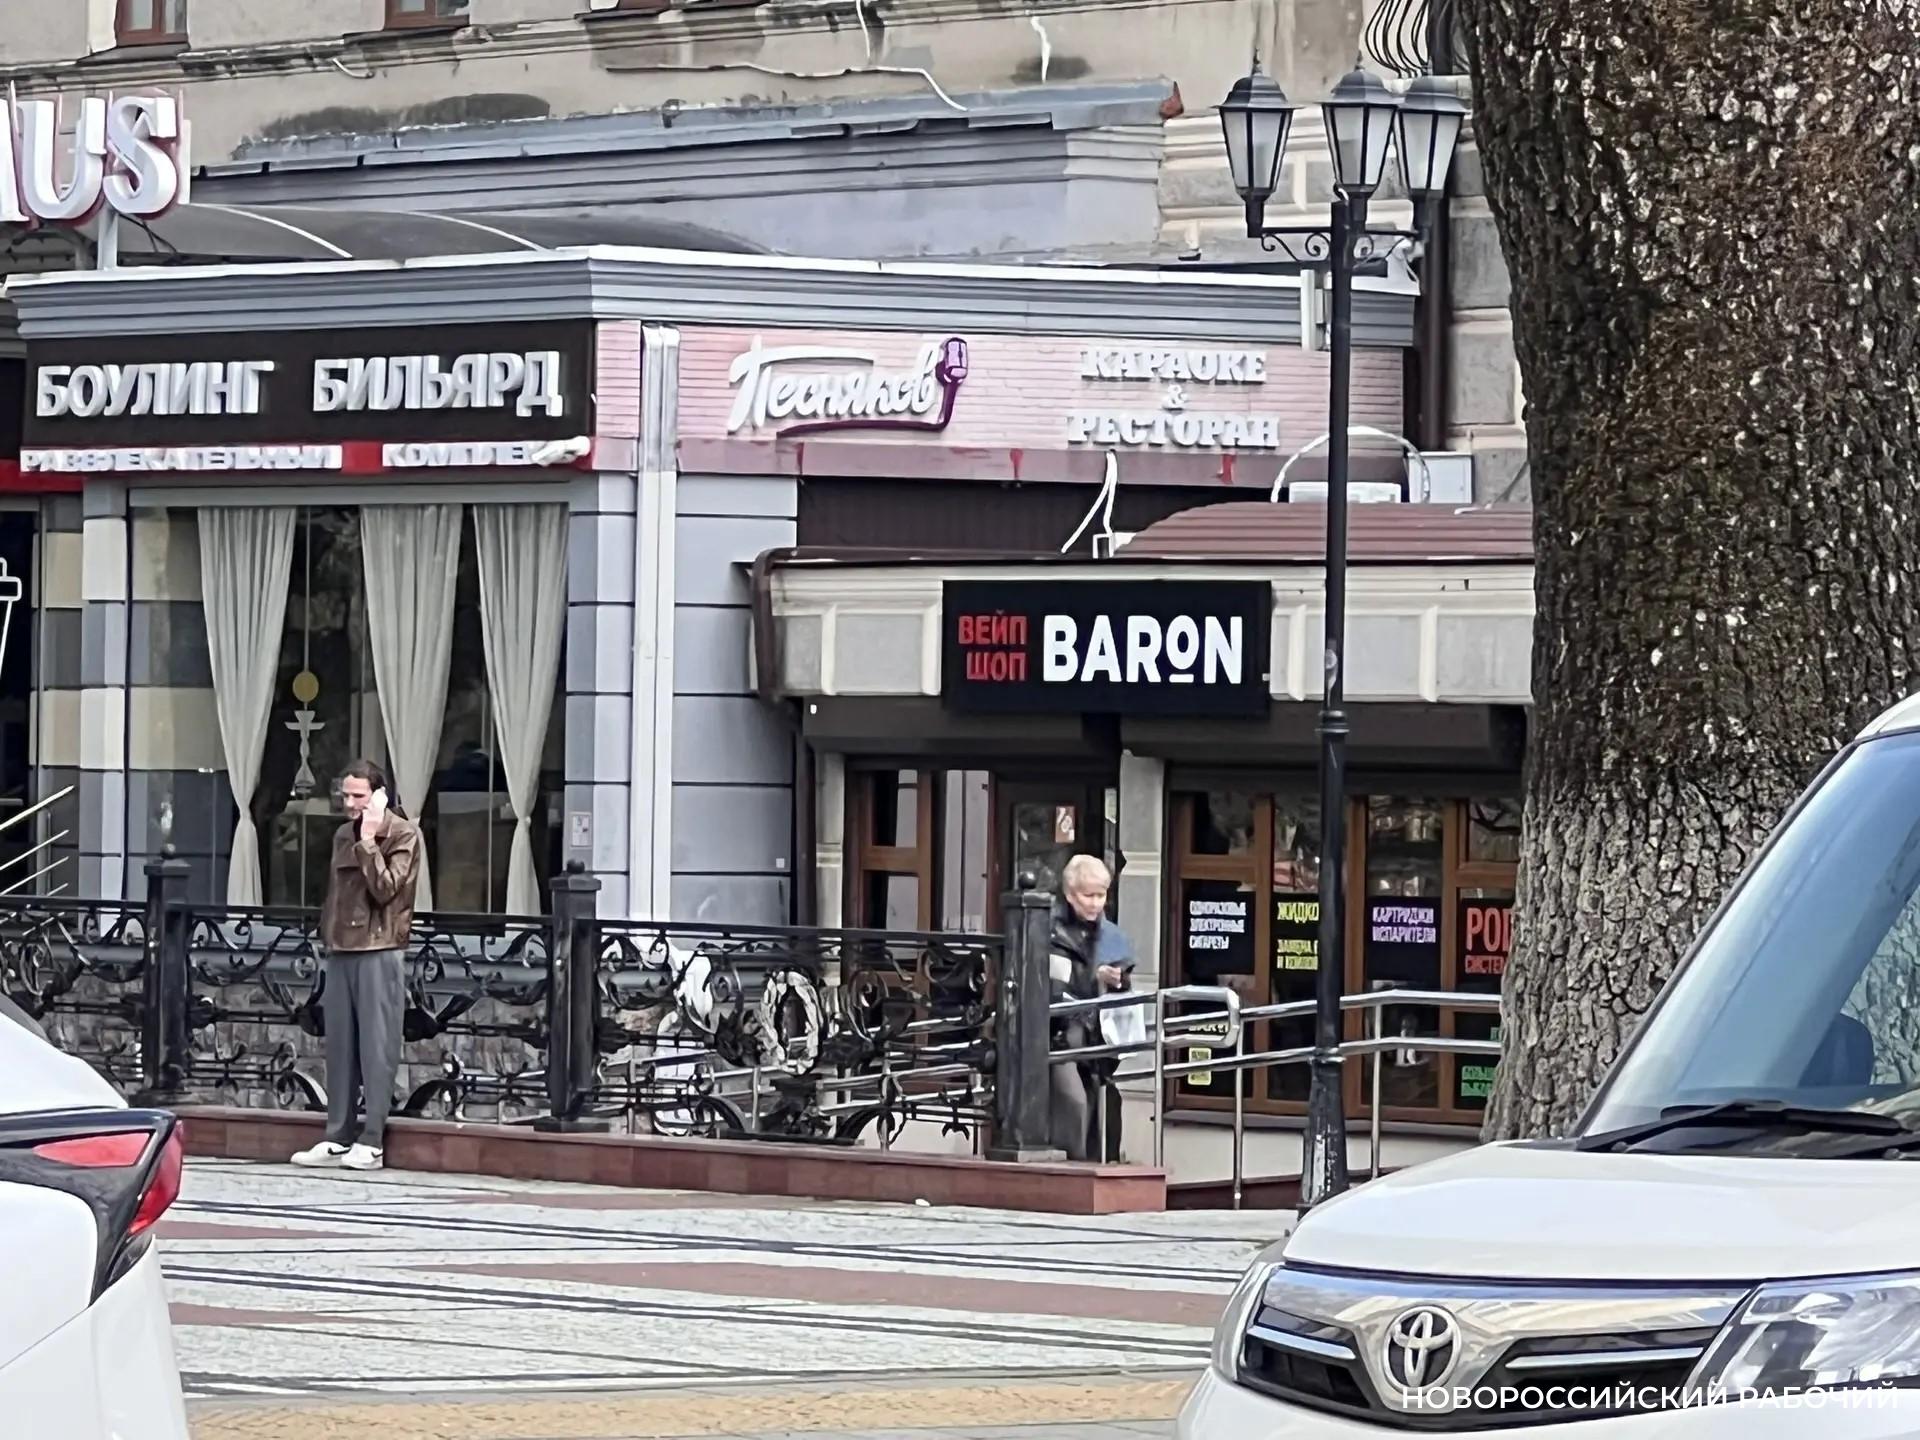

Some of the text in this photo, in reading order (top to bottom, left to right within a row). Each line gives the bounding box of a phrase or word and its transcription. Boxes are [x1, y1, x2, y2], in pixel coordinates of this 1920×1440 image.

[0, 96, 177, 221] US
[37, 351, 563, 417] БОУЛИНГ БИЛЬЯРД
[1080, 350, 1267, 384] КАРАОКЕ
[1163, 384, 1190, 411] &
[1067, 413, 1280, 449] РЕСТОРАН
[958, 609, 1027, 645] ВЕЙП
[966, 652, 1026, 681] ШОП
[1043, 614, 1243, 684] BARON
[1277, 902, 1319, 923] ЖИДКО
